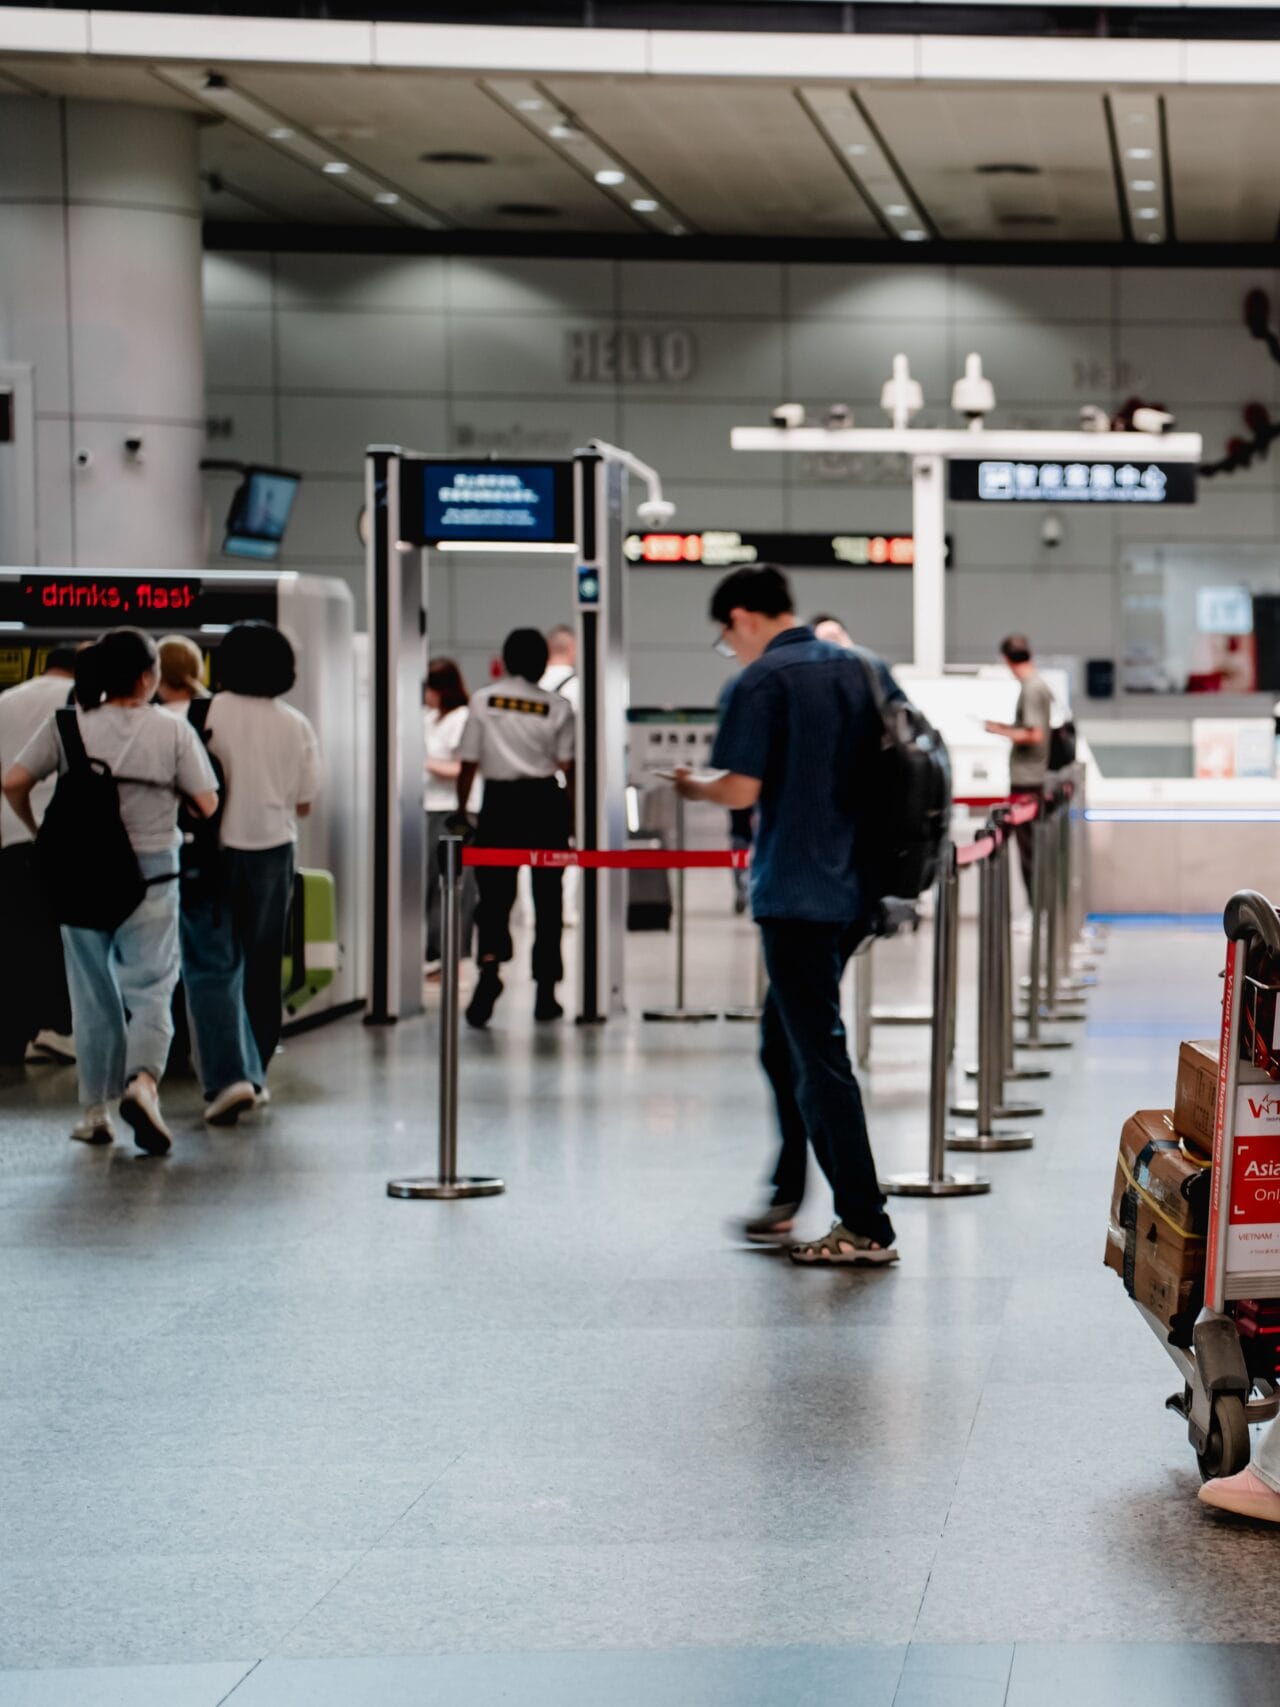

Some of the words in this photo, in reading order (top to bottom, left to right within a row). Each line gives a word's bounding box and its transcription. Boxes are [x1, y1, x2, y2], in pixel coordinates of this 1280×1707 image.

[567, 329, 698, 384] HELLO
[42, 583, 129, 612] drinks,
[1220, 1026, 1230, 1078] Helping
[1217, 1081, 1226, 1126] Buyers
[1215, 1128, 1223, 1163] Sleep
[1238, 1232, 1273, 1241] VIETNAM
